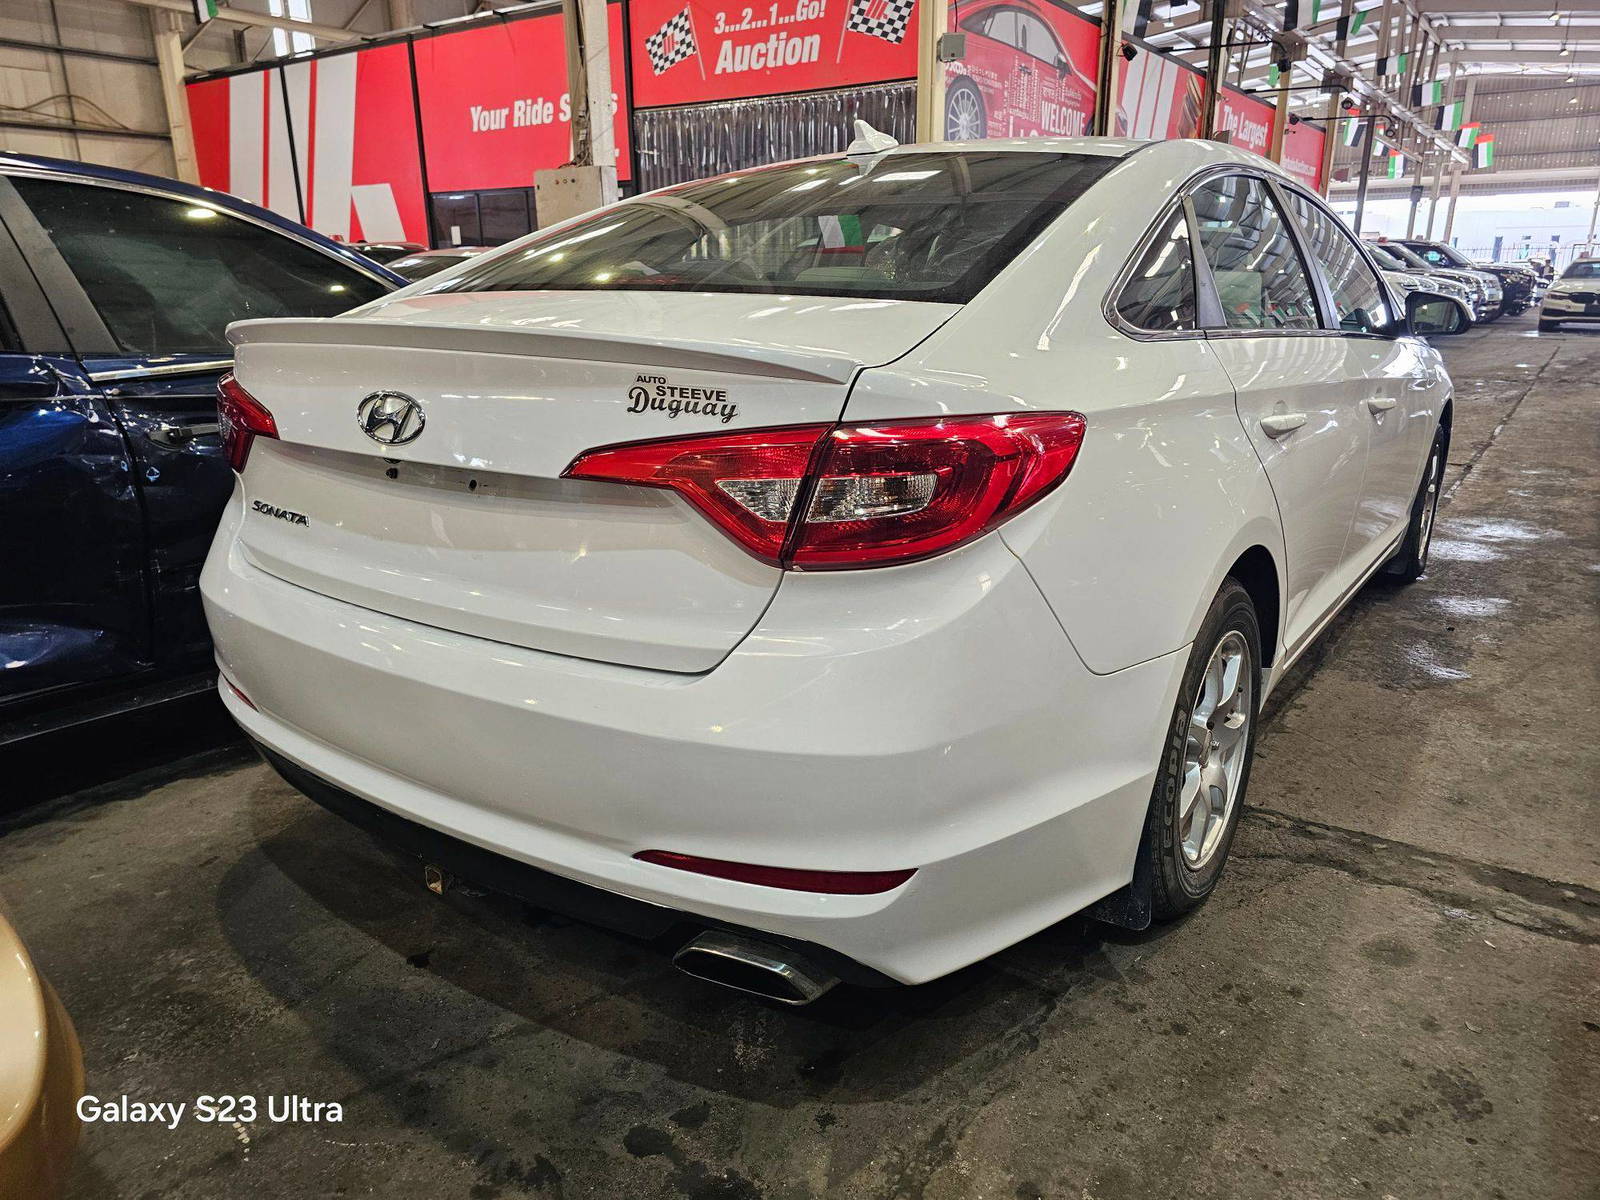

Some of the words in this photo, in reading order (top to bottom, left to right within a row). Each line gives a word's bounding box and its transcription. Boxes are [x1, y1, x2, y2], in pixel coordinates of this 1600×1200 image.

[714, 31, 821, 75] Auction
[470, 105, 509, 132] Your
[513, 97, 554, 127] Ride
[1041, 100, 1087, 137] WELCOME
[1222, 104, 1239, 138] The
[1238, 111, 1269, 150] Largest
[636, 375, 667, 385] AUTO
[656, 385, 727, 402] STEEVE
[626, 386, 738, 424] Duguay
[252, 500, 310, 528] SONATA
